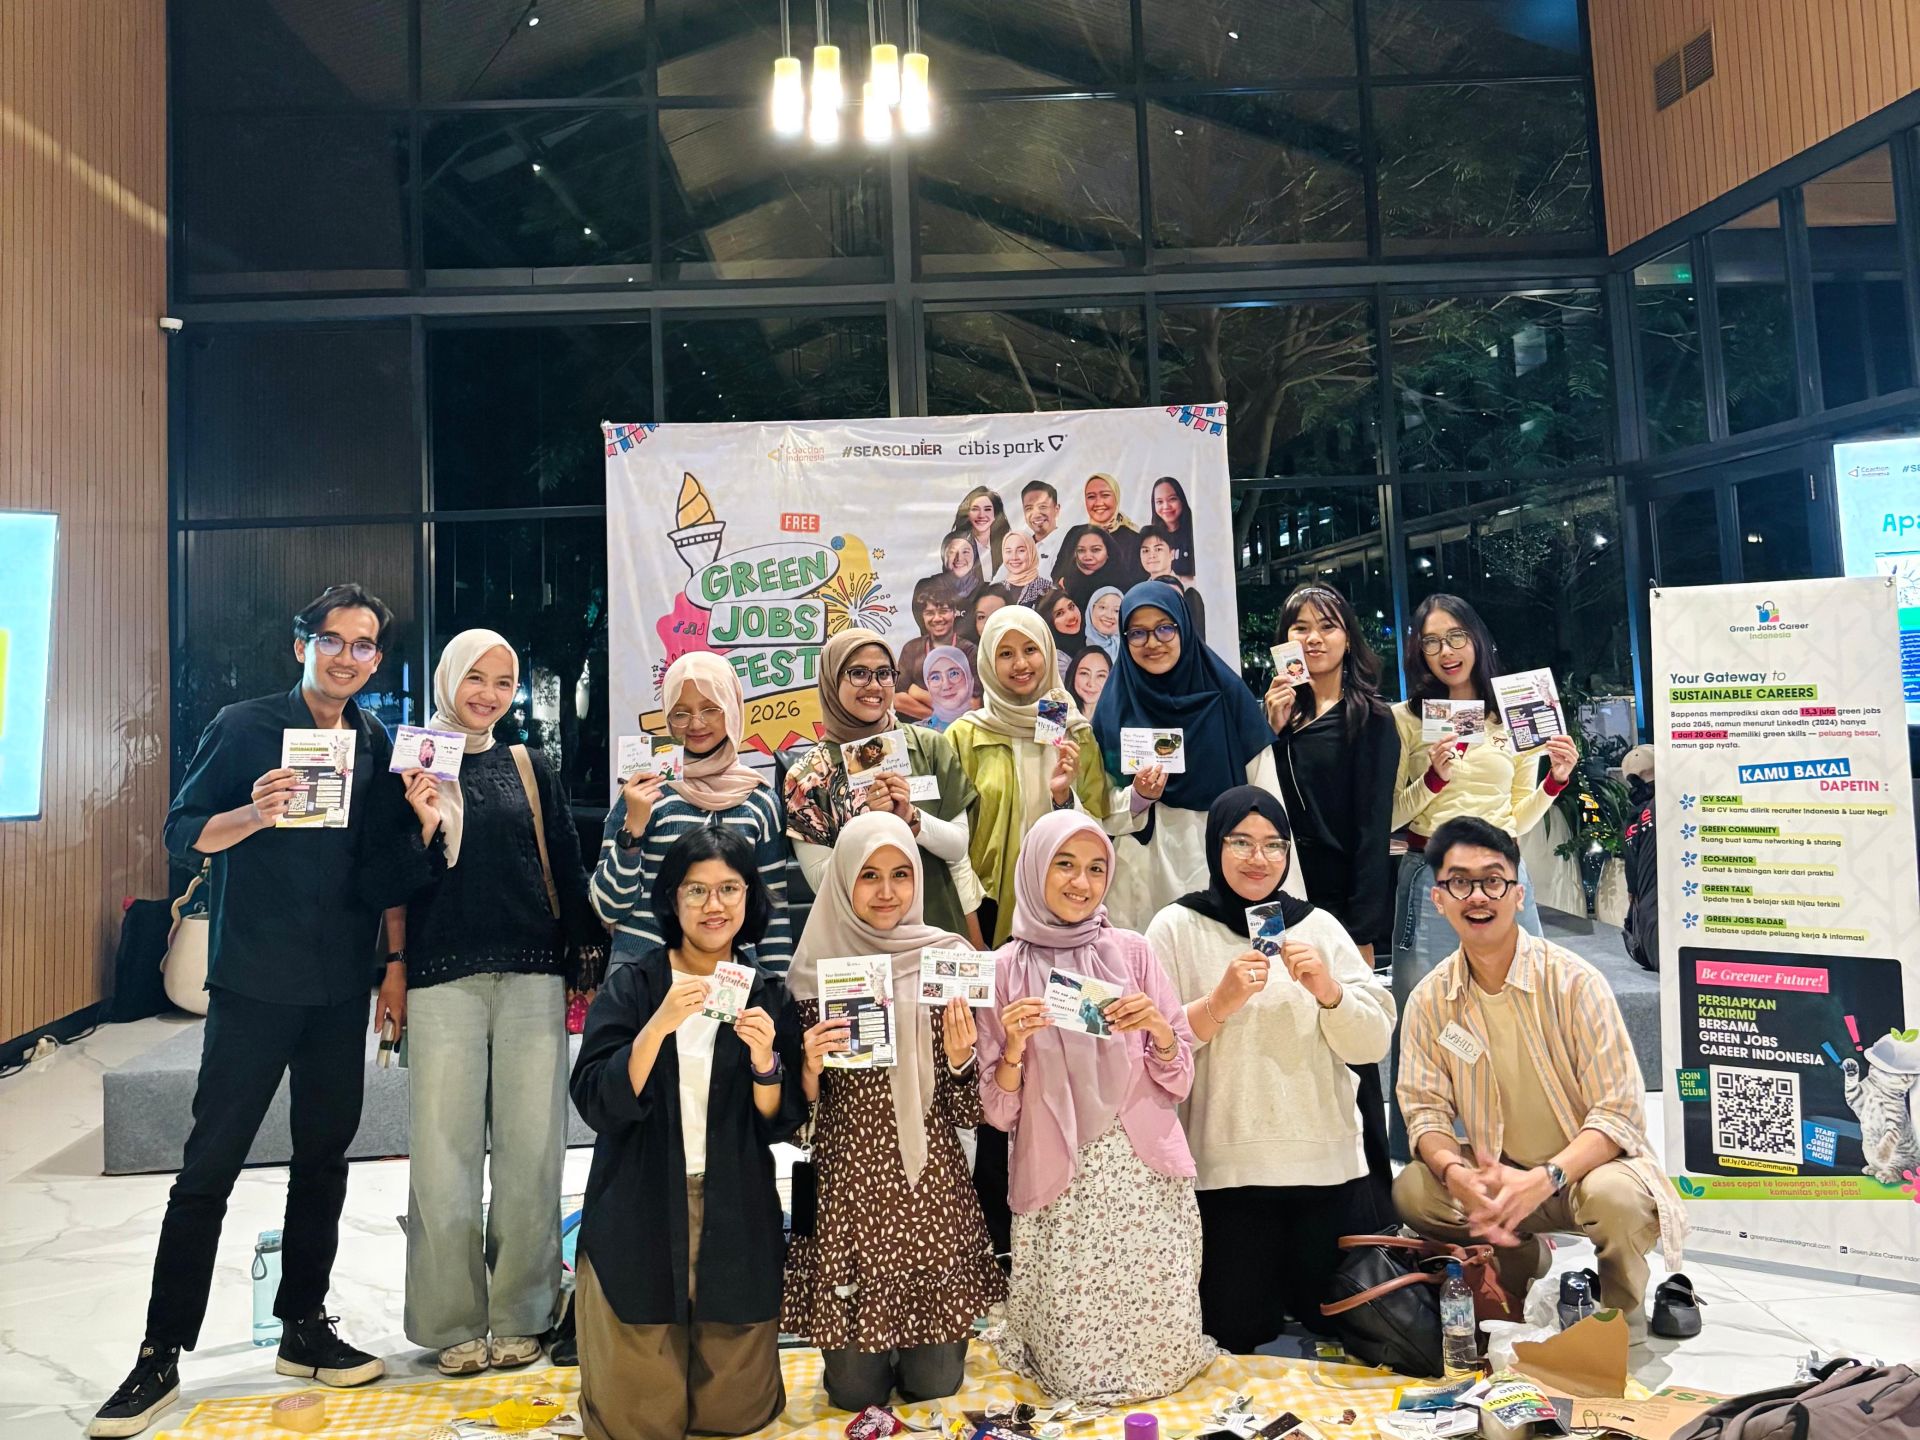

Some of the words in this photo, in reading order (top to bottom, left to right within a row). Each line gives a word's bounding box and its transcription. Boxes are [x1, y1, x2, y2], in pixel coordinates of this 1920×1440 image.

[786, 446, 824, 454] Coaction
[842, 439, 942, 458] #SEASOLDIER
[958, 441, 1000, 456] cibis
[1003, 440, 1045, 458] park
[785, 515, 816, 530] FREE
[701, 551, 829, 601] GREEN
[712, 604, 820, 642] JOBS
[1750, 632, 1792, 640] Indonesia
[728, 647, 824, 688] FEST
[1670, 673, 1700, 684] Your
[1703, 672, 1767, 684] Gateway
[1772, 670, 1786, 681] to
[1672, 689, 1753, 701] SUSTAINABLE
[1756, 687, 1814, 699] CAREERS
[750, 700, 801, 725] 2026
[1710, 709, 1758, 717] memprediksi
[1820, 708, 1836, 716] juta
[1837, 708, 1861, 716] green
[1812, 719, 1838, 727] (2024)
[1840, 719, 1866, 727] hanya
[1818, 730, 1852, 738] peluang
[1741, 766, 1789, 782] KAMU
[1793, 762, 1849, 778] BAKAL
[1820, 780, 1879, 792] DAPETIN
[1728, 826, 1777, 834] COMMUNITY
[1701, 836, 1723, 844] Ruang
[1764, 838, 1804, 846] networking
[1814, 839, 1841, 847] sharing
[1704, 855, 1754, 863] ECO-MENTOR
[1753, 898, 1779, 906] belajar
[1734, 916, 1754, 924] JOBS
[1741, 928, 1767, 936] update
[1769, 930, 1799, 939] peluang
[1830, 933, 1864, 941] informasi
[1702, 968, 1717, 980] Be
[1720, 968, 1772, 984] Greener
[1775, 972, 1824, 987] Future!
[1698, 994, 1777, 1010] PERSIAPKAN
[1698, 1006, 1757, 1020] KARIRMU
[1698, 1018, 1759, 1033] BERSAMA
[1699, 1031, 1740, 1044] GREEN
[1743, 1035, 1778, 1047] JOBS
[1699, 1044, 1749, 1059] CAREER
[1752, 1048, 1825, 1066] INDONESIA
[1679, 1072, 1700, 1080] JOIN
[1680, 1080, 1696, 1088] THE
[1681, 1088, 1707, 1096] CLUB!
[1814, 1127, 1836, 1138] START
[1815, 1133, 1835, 1143] YOUR
[1806, 1144, 1833, 1155] CAREER
[1811, 1139, 1834, 1150] GREEN
[1812, 1152, 1832, 1162] NOW!
[1737, 1180, 1761, 1188] cepat
[1775, 1180, 1819, 1189] lowongan,
[1820, 1180, 1839, 1188] skill,
[1841, 1189, 1862, 1197] jobs!
[1499, 1383, 1538, 1395] Guide
[1488, 1392, 1532, 1407] Visitor
